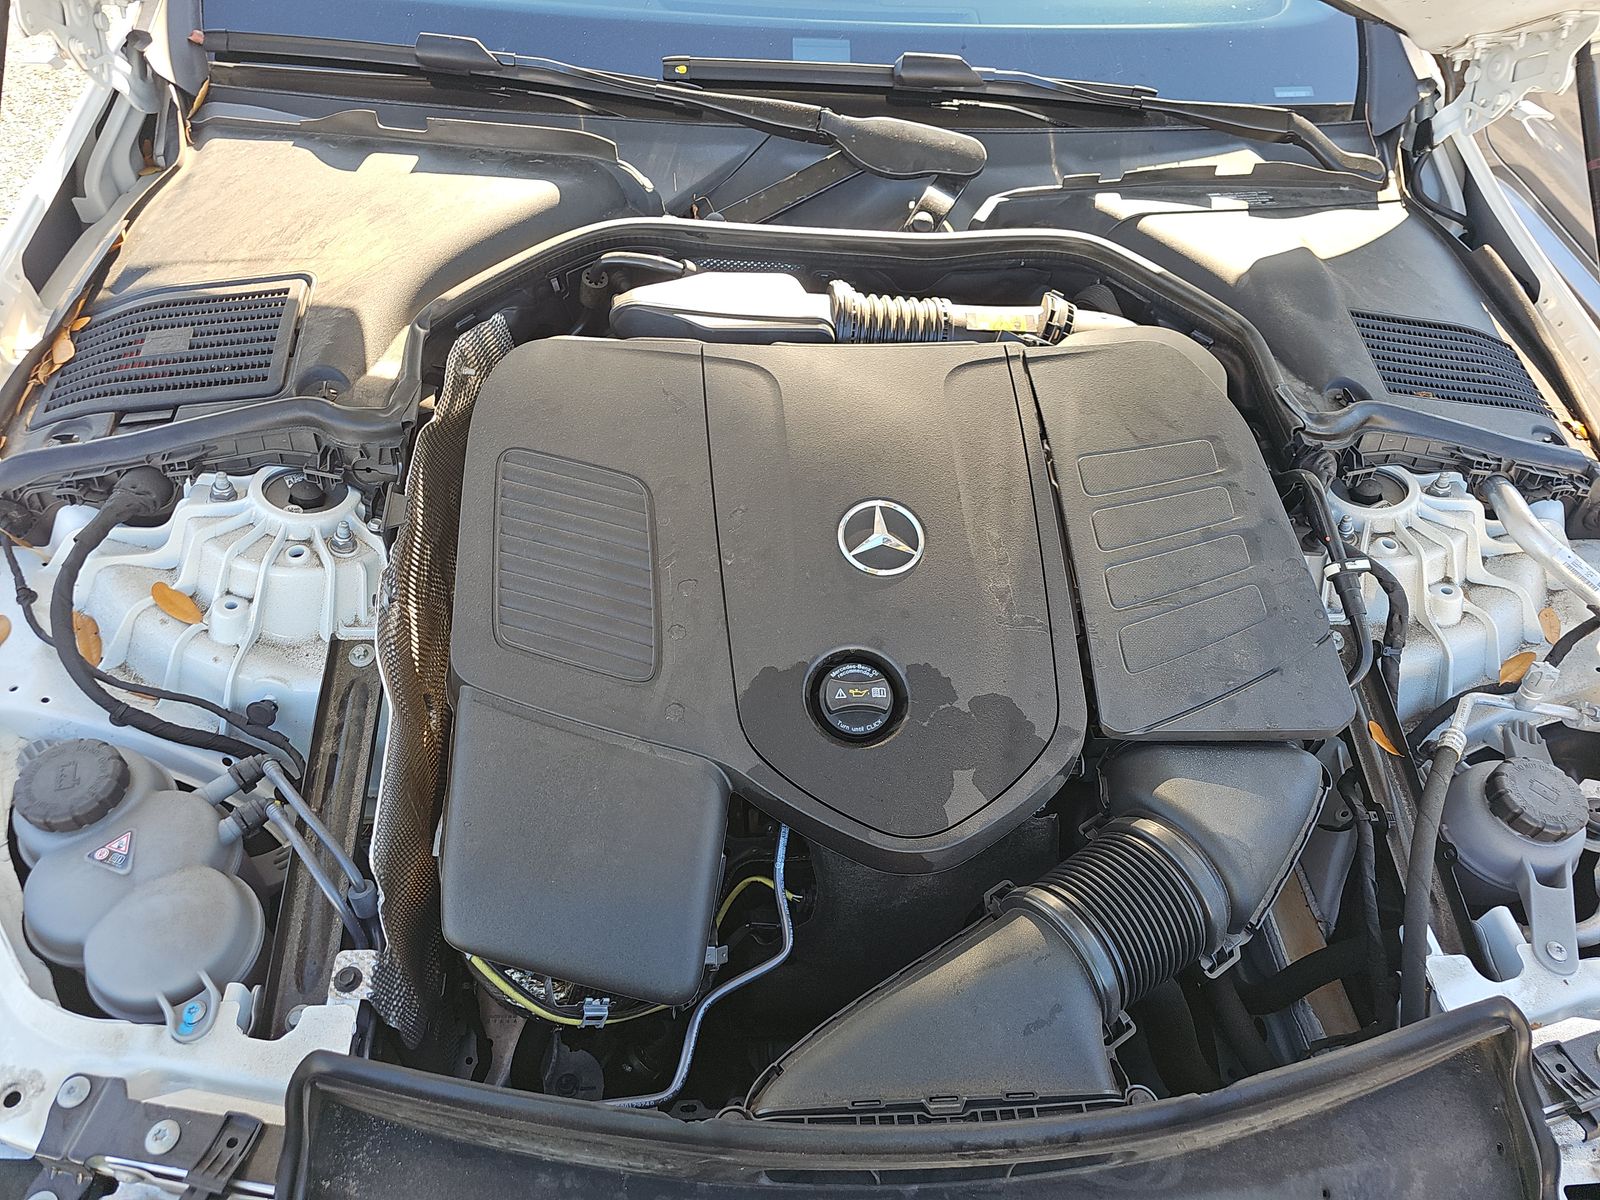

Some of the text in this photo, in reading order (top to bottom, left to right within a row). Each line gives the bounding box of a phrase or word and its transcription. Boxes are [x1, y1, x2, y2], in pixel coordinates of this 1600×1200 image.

[830, 664, 872, 678] Mercedes-Benz
[837, 669, 873, 678] recommended
[837, 720, 850, 730] Turn
[866, 719, 883, 731] CLICK
